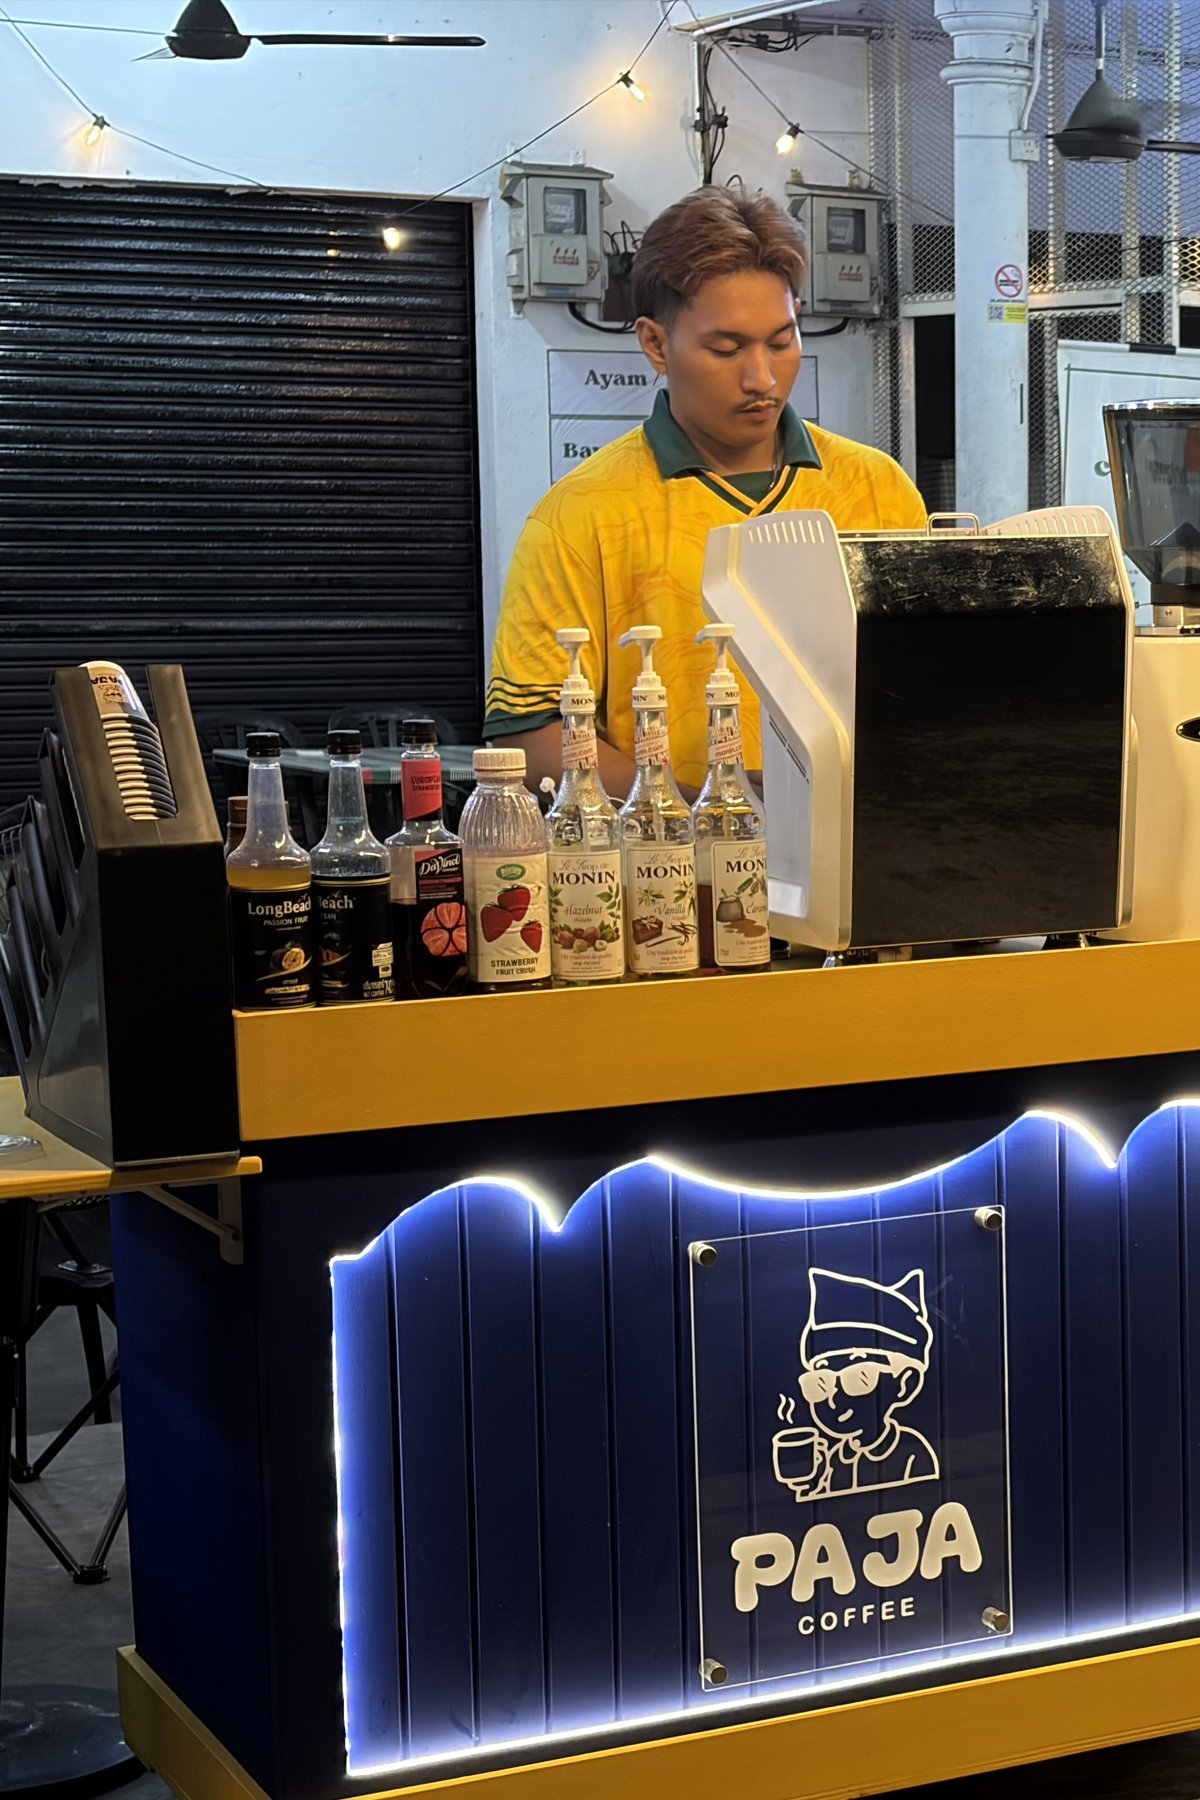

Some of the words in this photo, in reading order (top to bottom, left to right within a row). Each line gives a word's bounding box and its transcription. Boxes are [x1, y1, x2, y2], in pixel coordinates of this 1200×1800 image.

[585, 369, 647, 390] Ayam
[553, 871, 616, 885] MONIN
[563, 903, 602, 916] Hazelnut
[654, 903, 686, 916] Vanilla
[264, 918, 293, 926] PASSION
[491, 957, 538, 968] STRAWBERRY
[496, 968, 514, 976] FRUIT
[731, 1502, 983, 1612] PAJA
[797, 1597, 916, 1636] COFFEE
